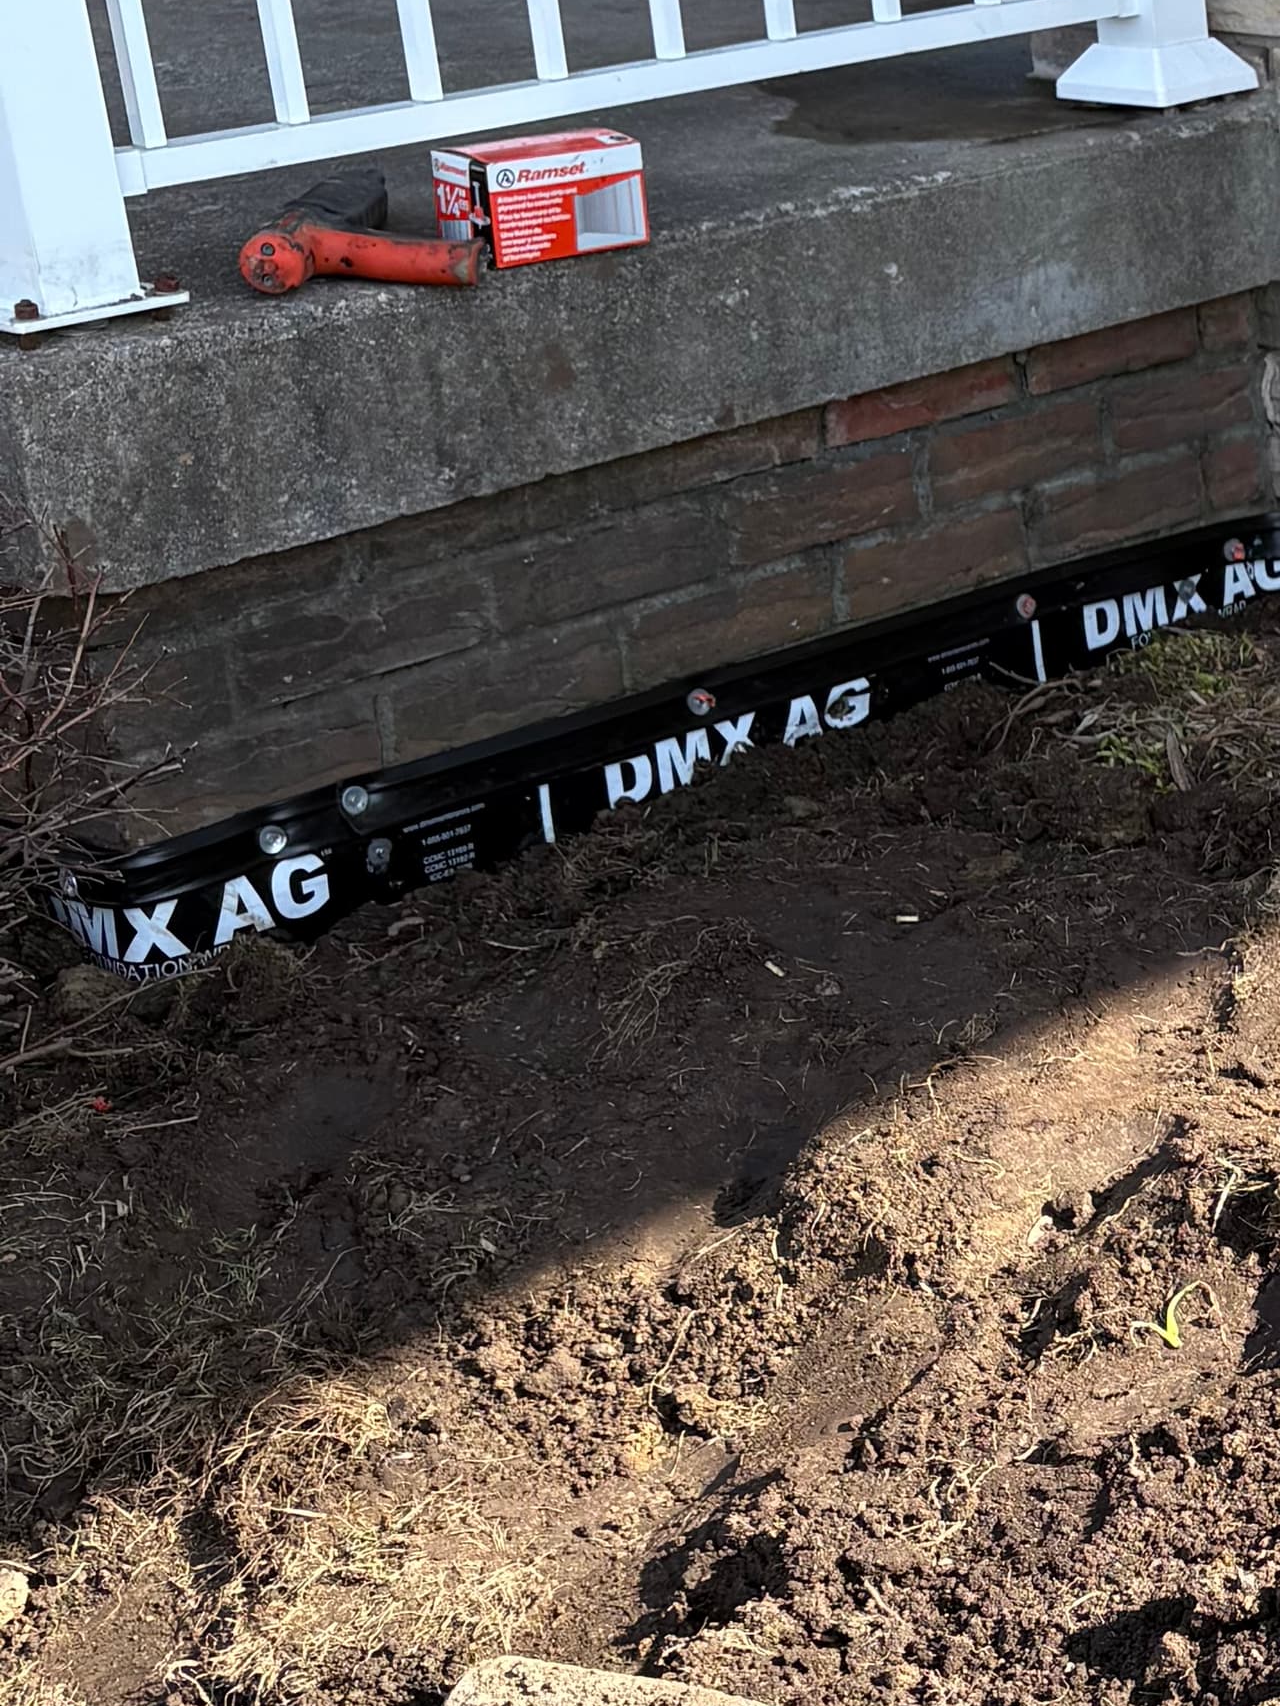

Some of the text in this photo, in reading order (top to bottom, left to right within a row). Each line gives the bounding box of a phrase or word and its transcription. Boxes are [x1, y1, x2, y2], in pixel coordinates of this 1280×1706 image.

[517, 162, 586, 183] Ramset
[1083, 573, 1207, 651] DMX
[604, 677, 871, 811] DMX AG
[213, 853, 330, 945] AG
